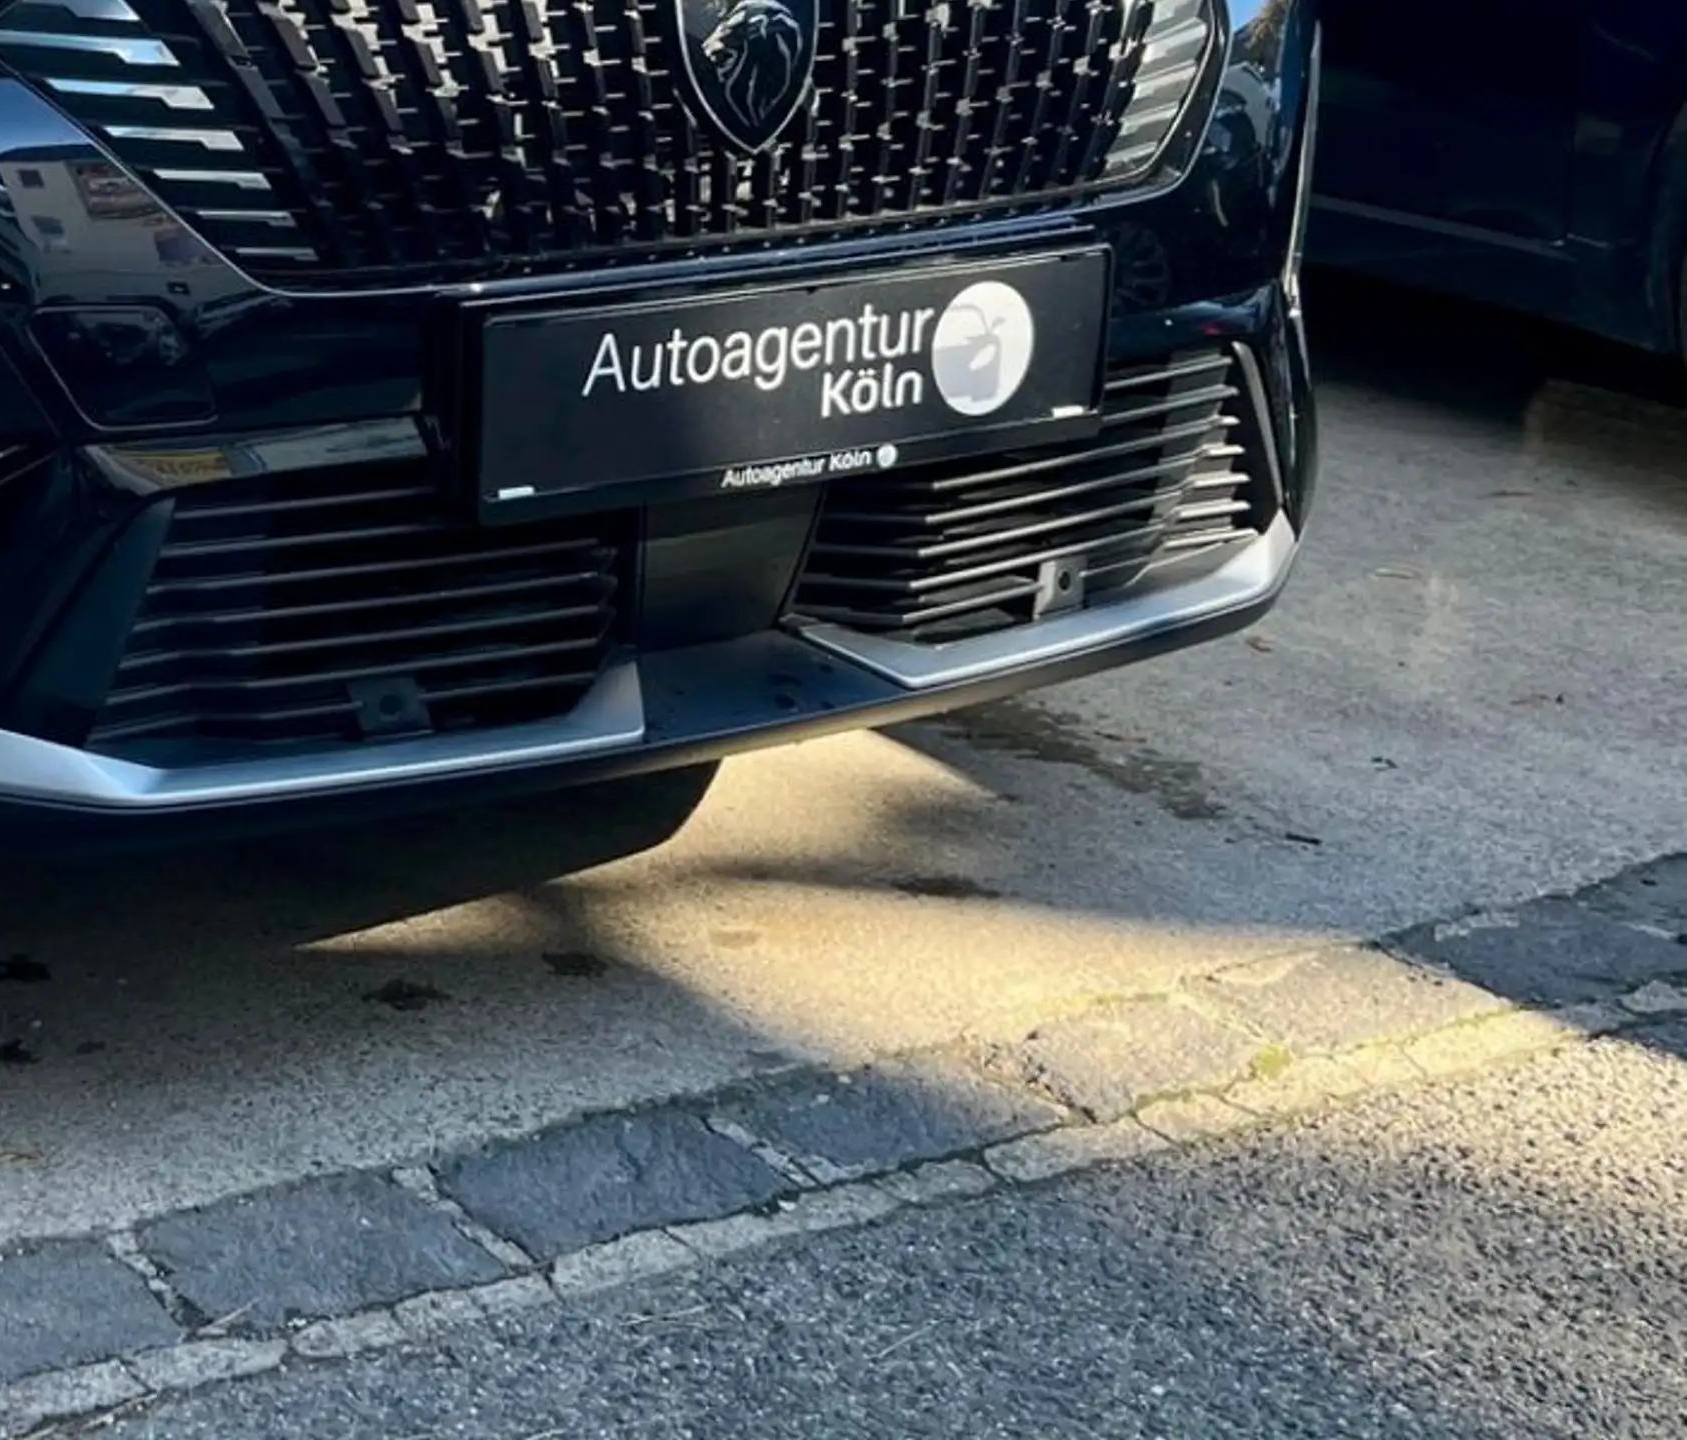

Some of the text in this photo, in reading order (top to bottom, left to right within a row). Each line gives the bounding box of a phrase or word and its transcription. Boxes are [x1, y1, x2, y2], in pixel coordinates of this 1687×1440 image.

[581, 303, 935, 397] Autoagentur
[820, 364, 923, 419] Köln
[720, 448, 873, 489] Autoagentur Köln
